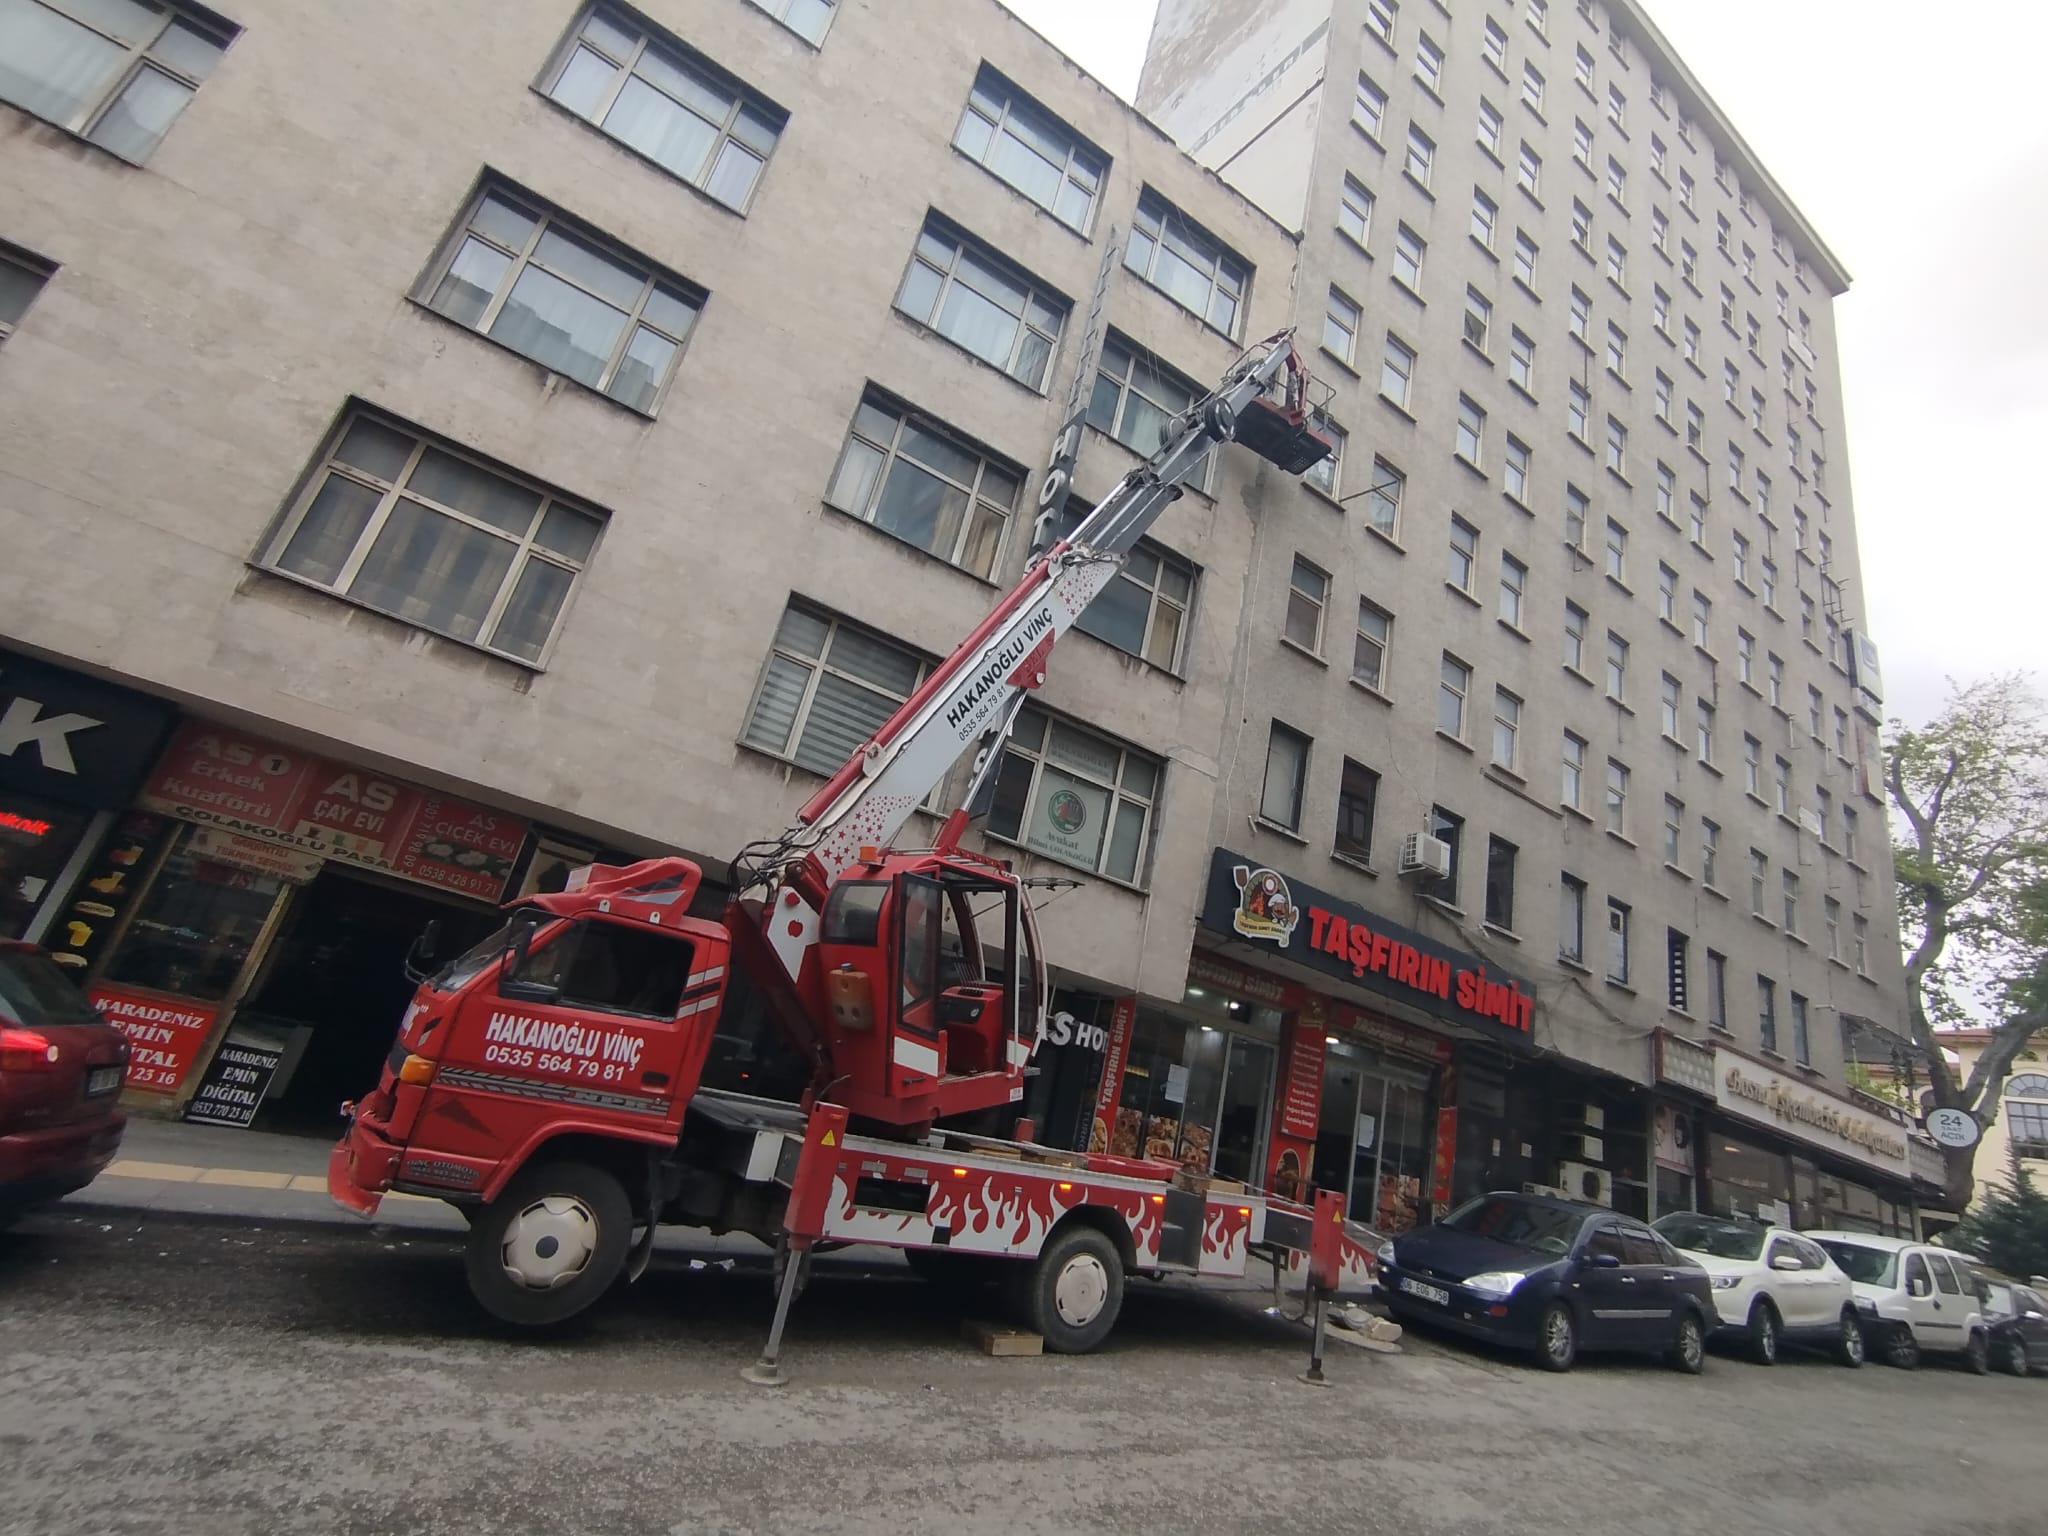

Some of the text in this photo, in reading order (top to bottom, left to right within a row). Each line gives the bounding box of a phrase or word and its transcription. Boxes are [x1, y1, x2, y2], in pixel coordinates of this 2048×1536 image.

[946, 637, 1024, 728] HAKANOĞLU
[1022, 607, 1053, 642] VİNÇ
[958, 685, 1007, 742] 0535 564 79 81
[184, 735, 256, 767] AS
[324, 773, 400, 812] AS
[314, 800, 352, 824] ÇAY
[468, 813, 497, 831] AS
[175, 805, 327, 851] ÇOLAKOĞLU
[418, 864, 446, 881] 0538
[1308, 905, 1534, 1032] TAŞFIRIN SİMİT
[95, 998, 204, 1029] KARADENİZ
[485, 1012, 644, 1071] HAKANOĞLU VİNÇ
[1101, 1045, 1122, 1104] TAŞFIRIN
[1113, 1006, 1129, 1043] SİMİT
[220, 1048, 279, 1069] KARADENİZ
[485, 1045, 625, 1081] 0535 564 79 81
[133, 1067, 156, 1081] 23
[156, 1071, 177, 1085] 16
[222, 1066, 260, 1084] EMİN
[201, 1082, 257, 1105] DİĞİTAL
[1940, 1114, 1963, 1126] 24
